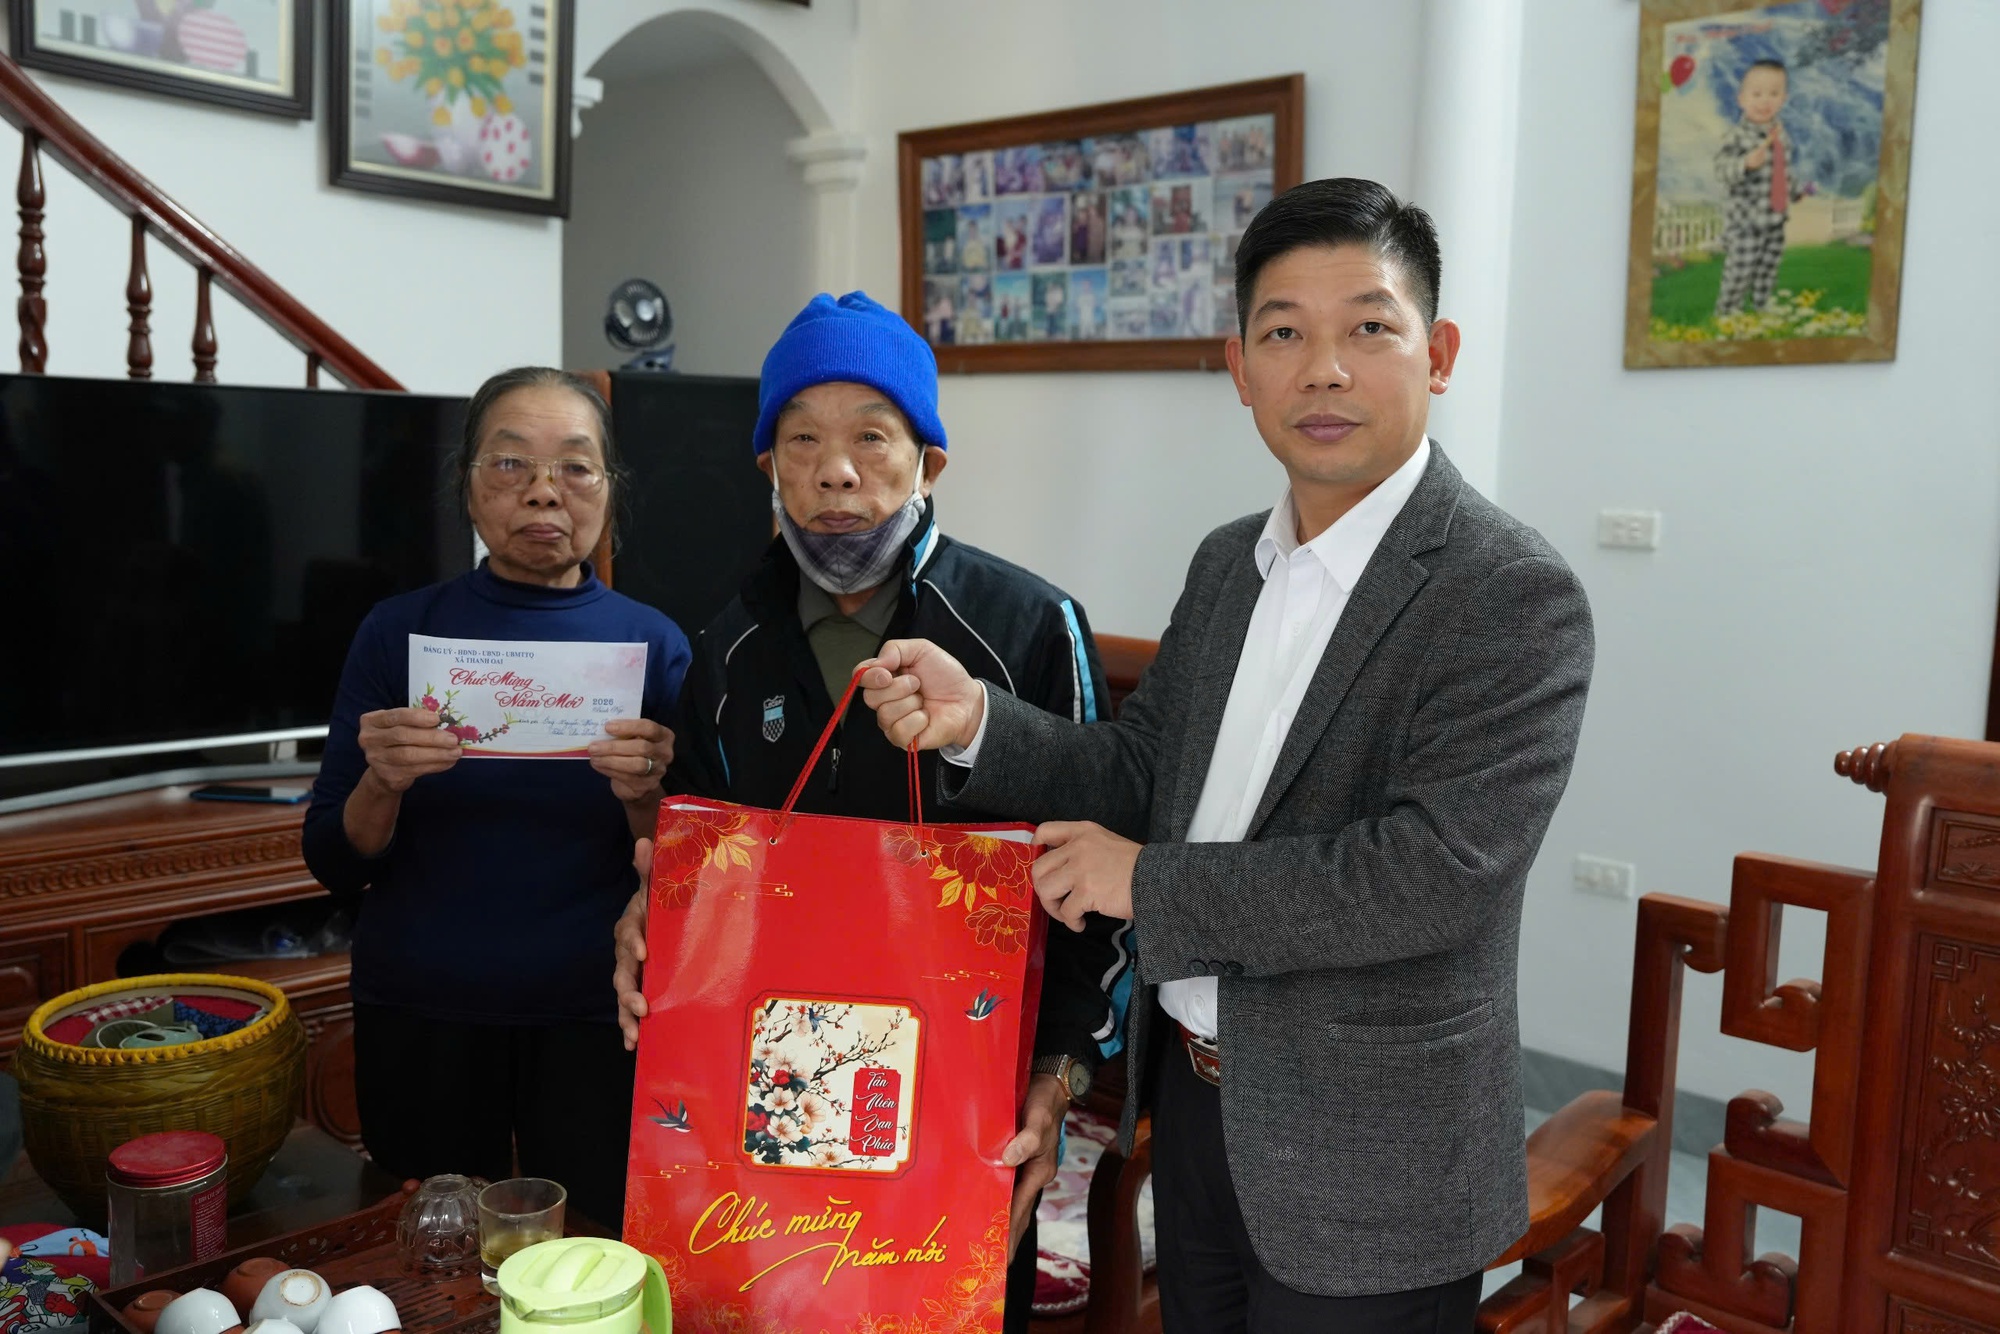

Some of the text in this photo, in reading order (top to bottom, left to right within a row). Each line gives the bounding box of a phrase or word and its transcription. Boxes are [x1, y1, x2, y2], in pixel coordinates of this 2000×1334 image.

[449, 667, 546, 692] Chúc Mừng
[495, 690, 585, 709] Năm Mới
[592, 698, 614, 706] 2026
[868, 1071, 888, 1090] Tân
[855, 1092, 896, 1111] Niên
[855, 1113, 894, 1133] Vạn
[850, 1134, 895, 1153] Phúc
[688, 1191, 863, 1286] Chúc mừng
[903, 1215, 948, 1263] mới
